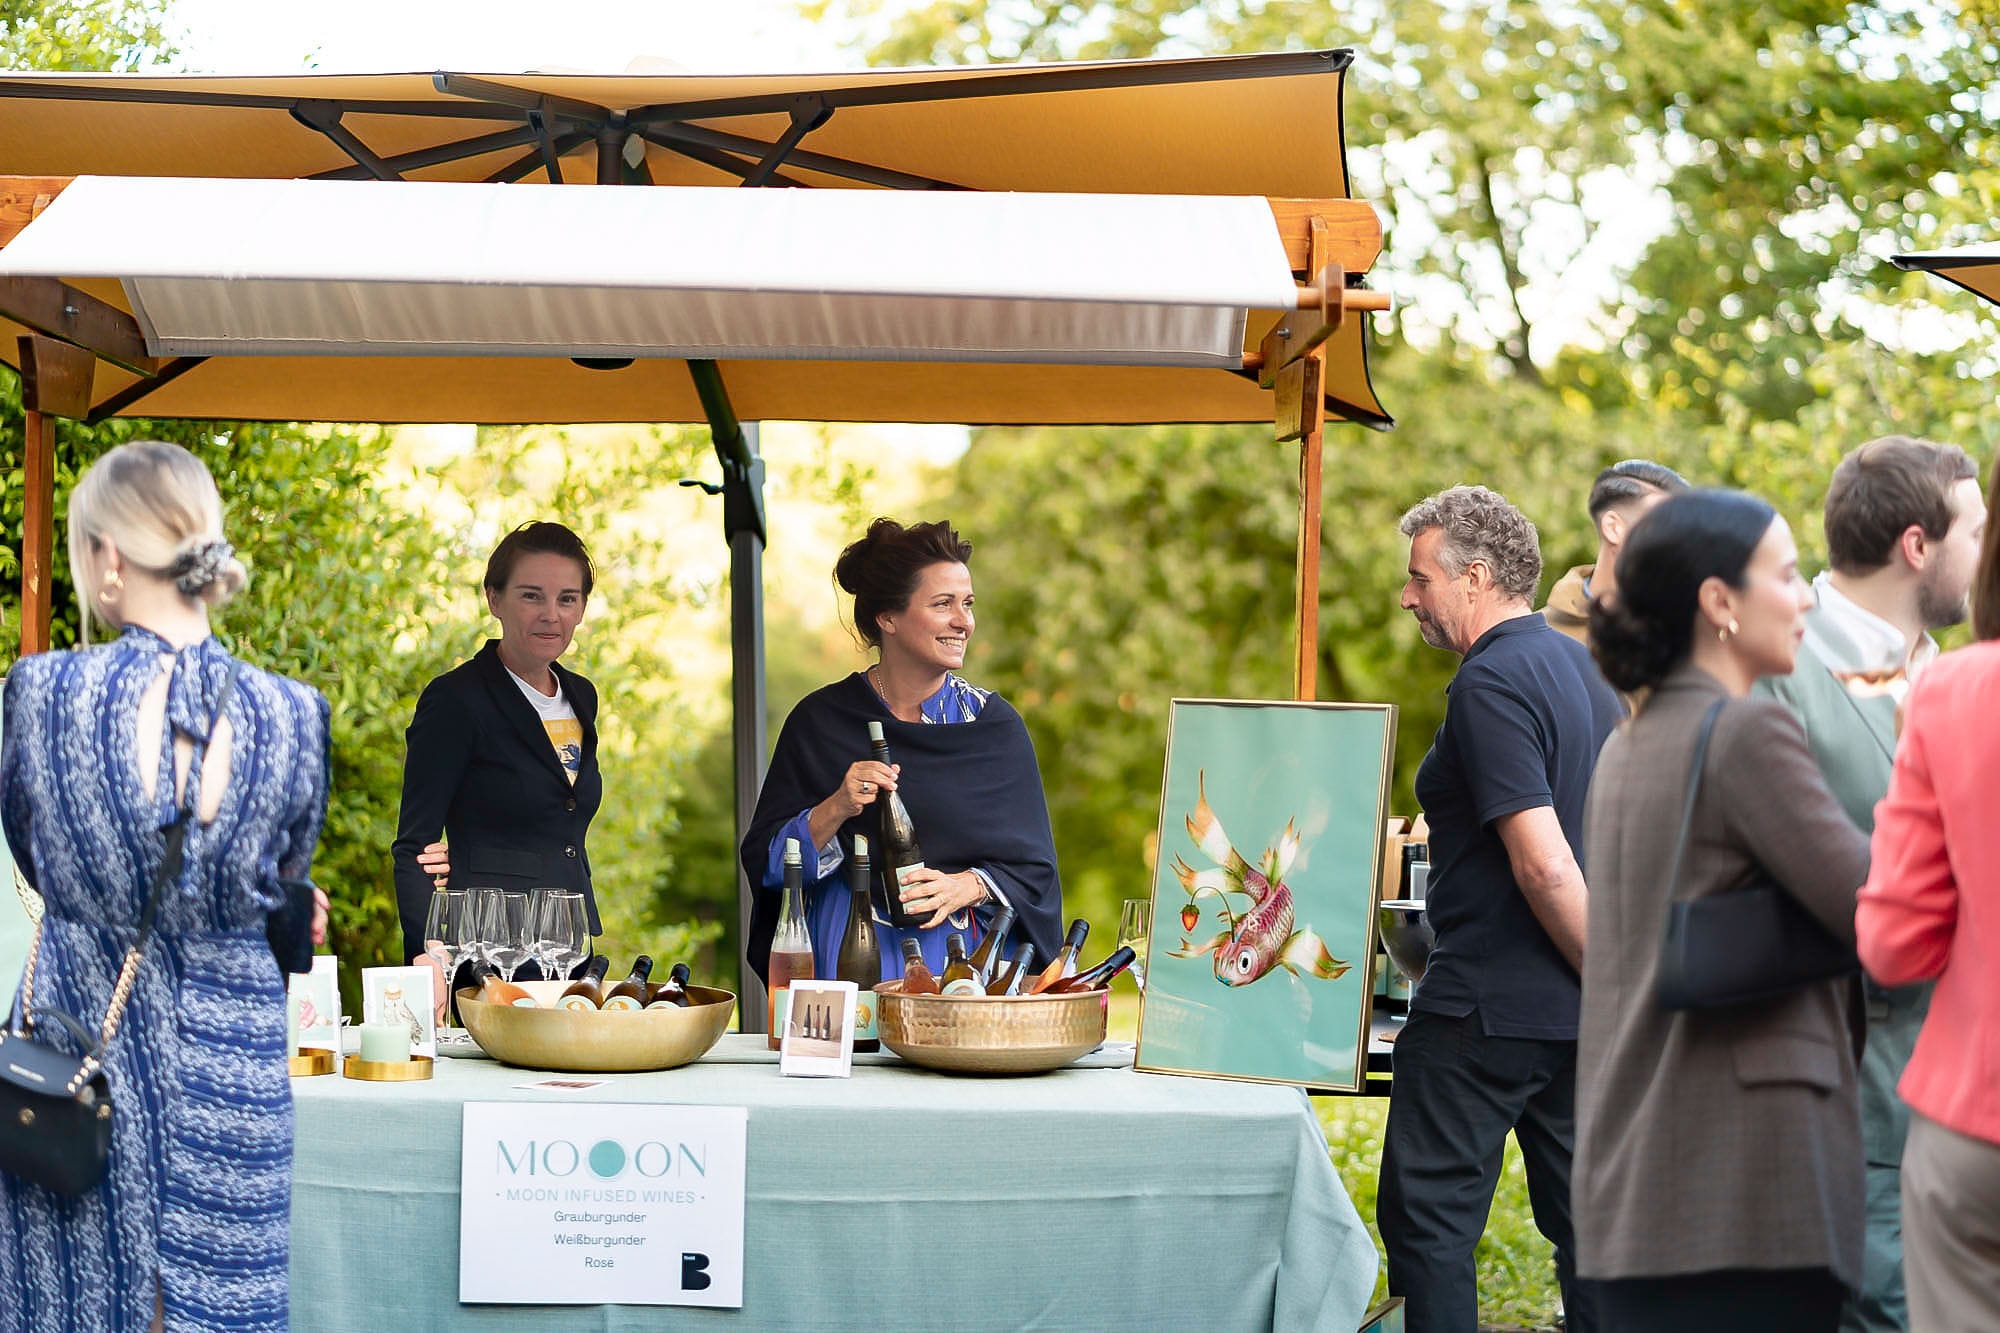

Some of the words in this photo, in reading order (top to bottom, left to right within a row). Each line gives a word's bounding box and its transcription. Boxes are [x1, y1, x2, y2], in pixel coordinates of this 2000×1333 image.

[506, 1189, 558, 1202] MOON
[565, 1190, 637, 1203] INFUSED
[642, 1190, 696, 1204] WINES
[553, 1210, 647, 1225] Grauburgunder
[553, 1233, 647, 1248] Weißburgunder
[681, 1252, 712, 1291] B
